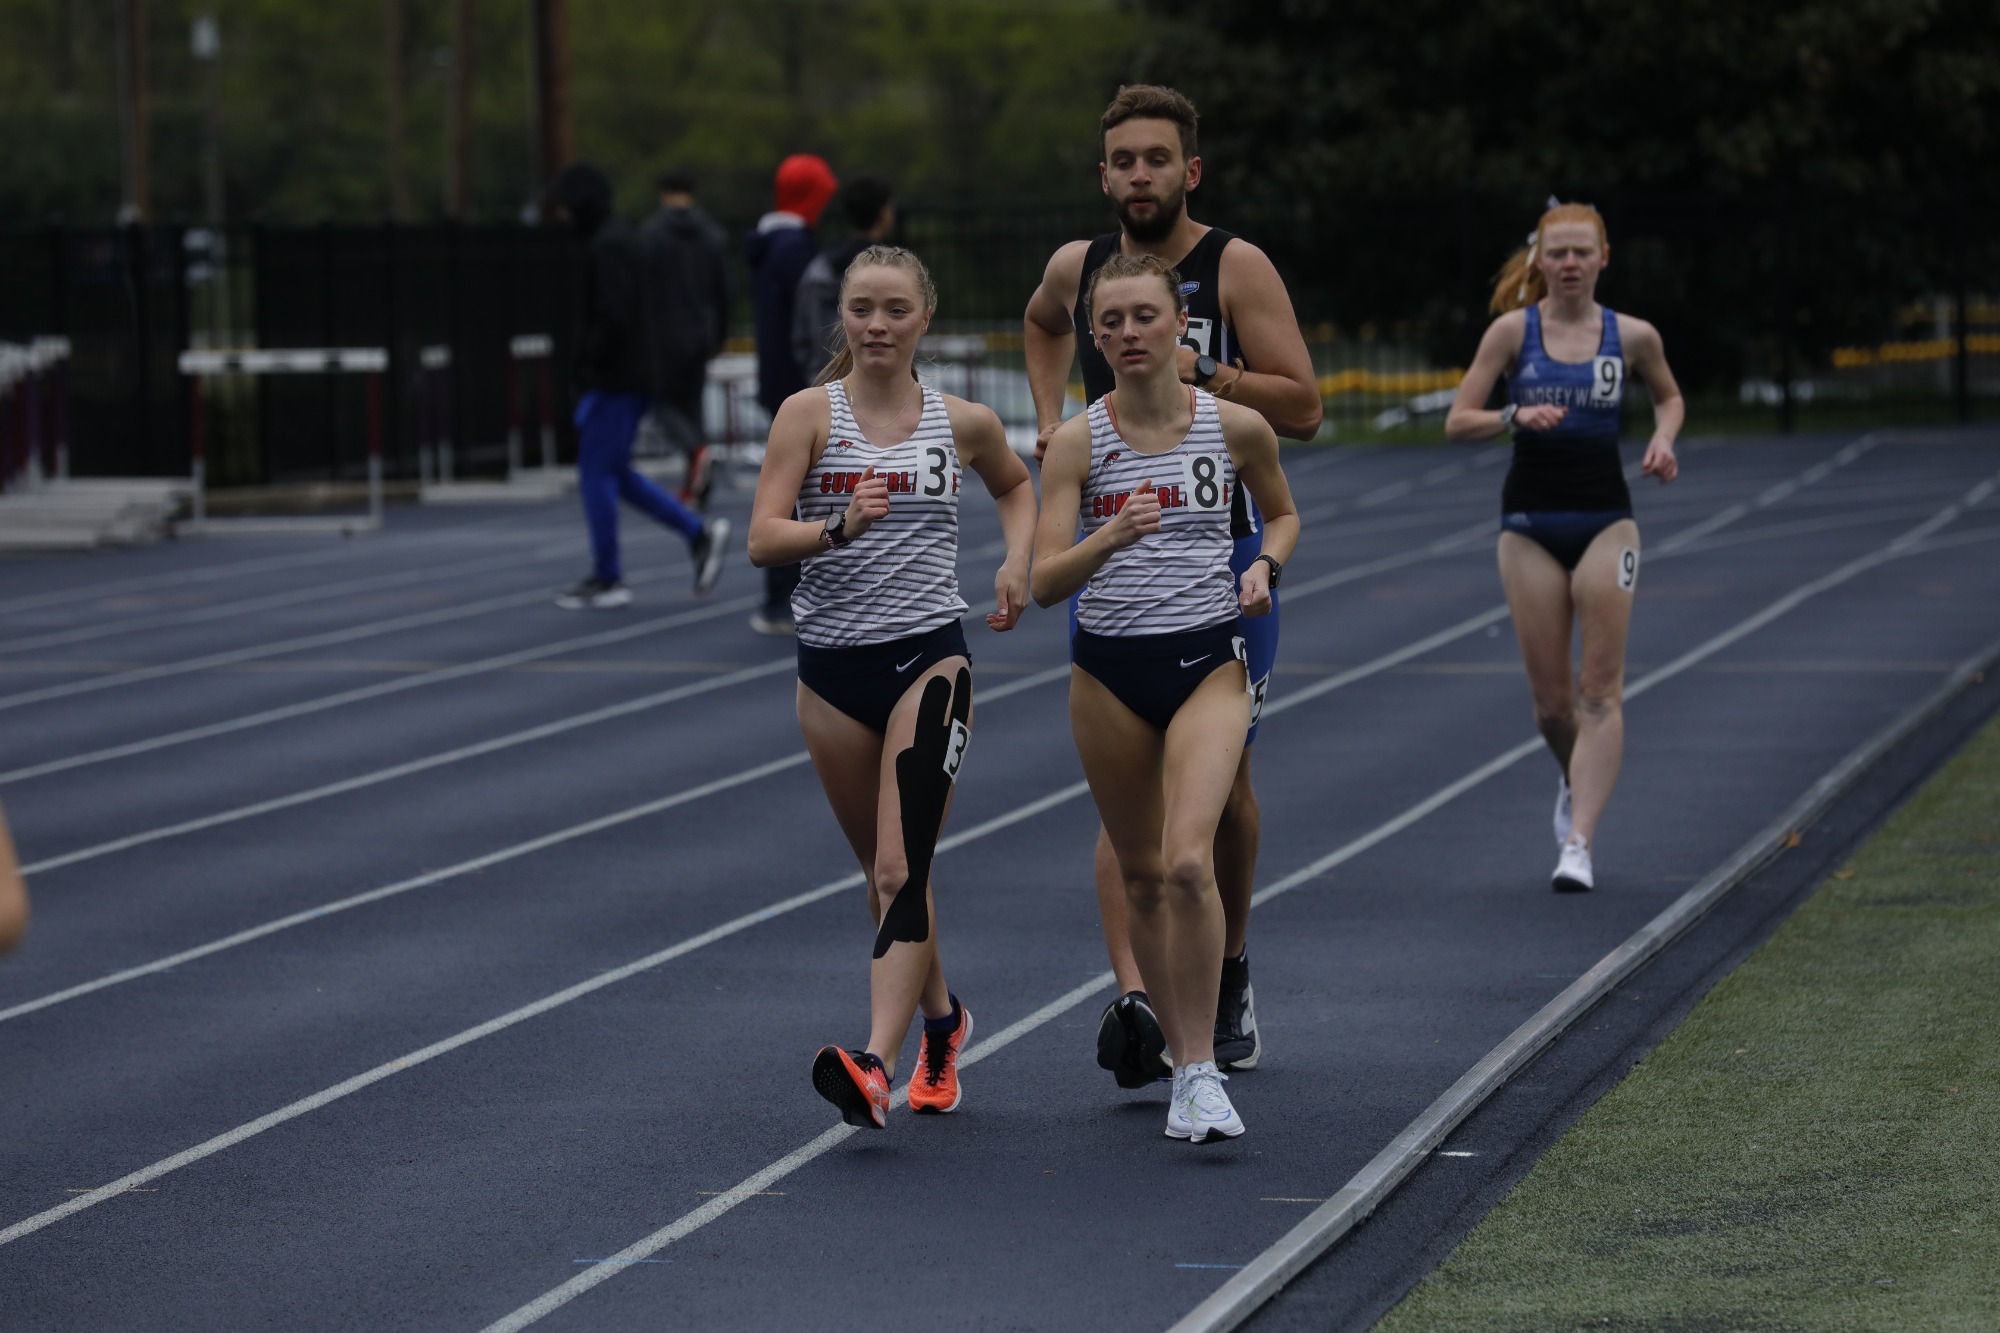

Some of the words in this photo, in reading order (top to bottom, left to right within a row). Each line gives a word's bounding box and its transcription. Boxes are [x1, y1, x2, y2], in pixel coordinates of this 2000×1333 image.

[1601, 360, 1616, 397] 9
[924, 447, 947, 497] 3
[1192, 456, 1219, 509] 8
[1624, 551, 1635, 587] 9
[1251, 678, 1267, 724] 5
[949, 725, 968, 776] 3
